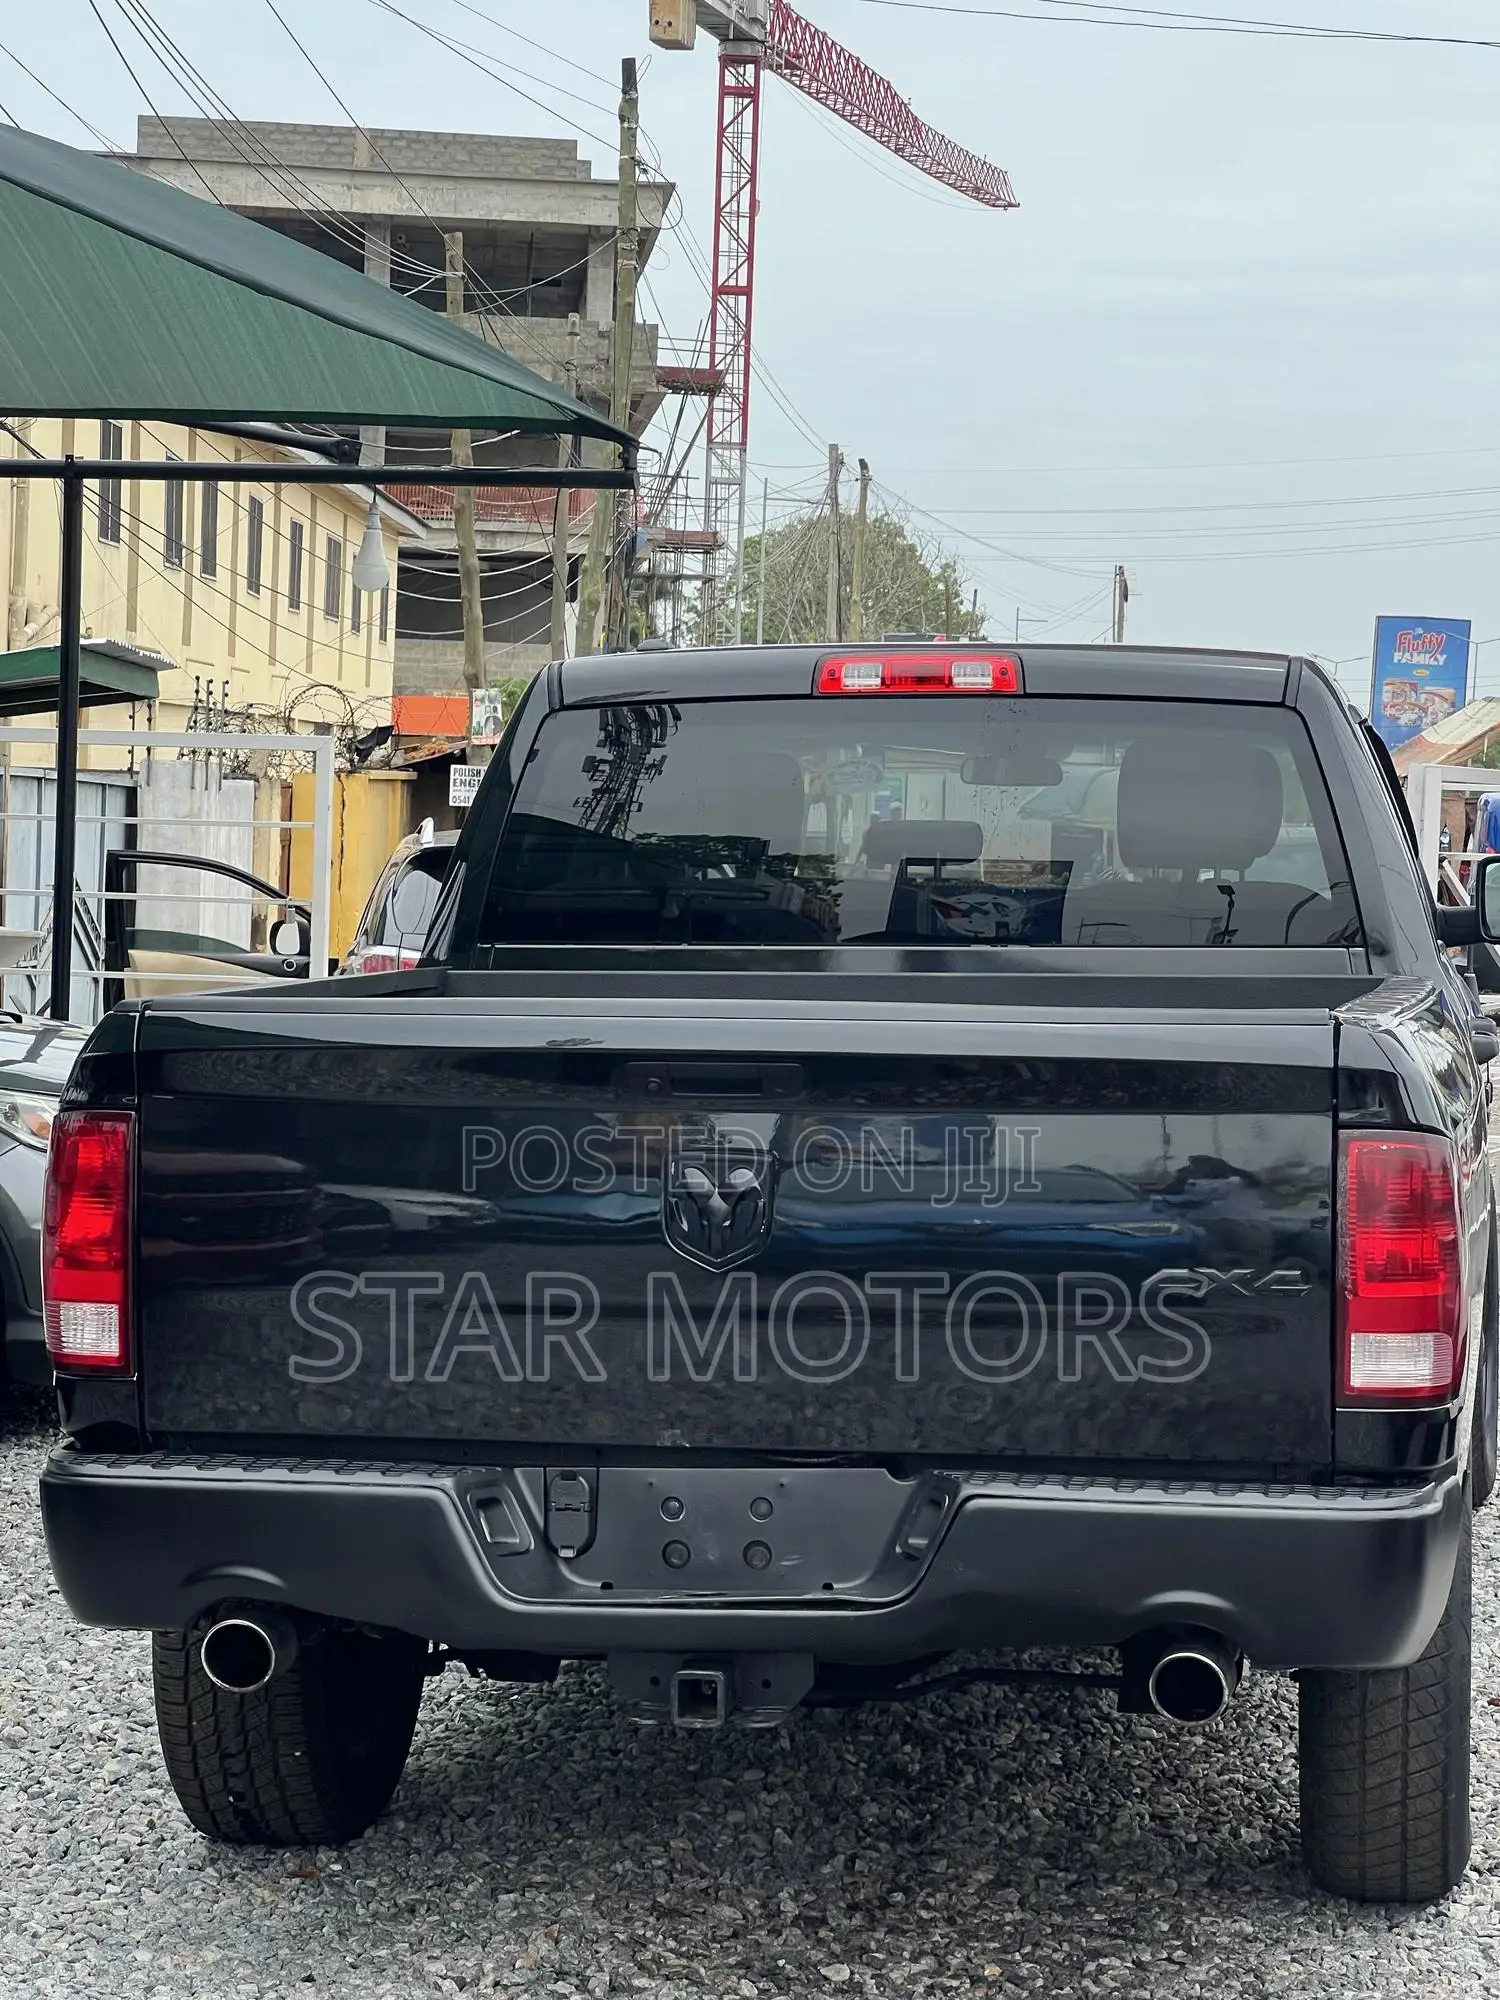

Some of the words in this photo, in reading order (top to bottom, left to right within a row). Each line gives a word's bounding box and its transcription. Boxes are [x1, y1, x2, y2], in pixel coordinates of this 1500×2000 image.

[1397, 630, 1446, 660] Fluffy
[1393, 652, 1447, 665] FAMILY
[453, 767, 481, 777] POLISH
[451, 795, 470, 804] 0541
